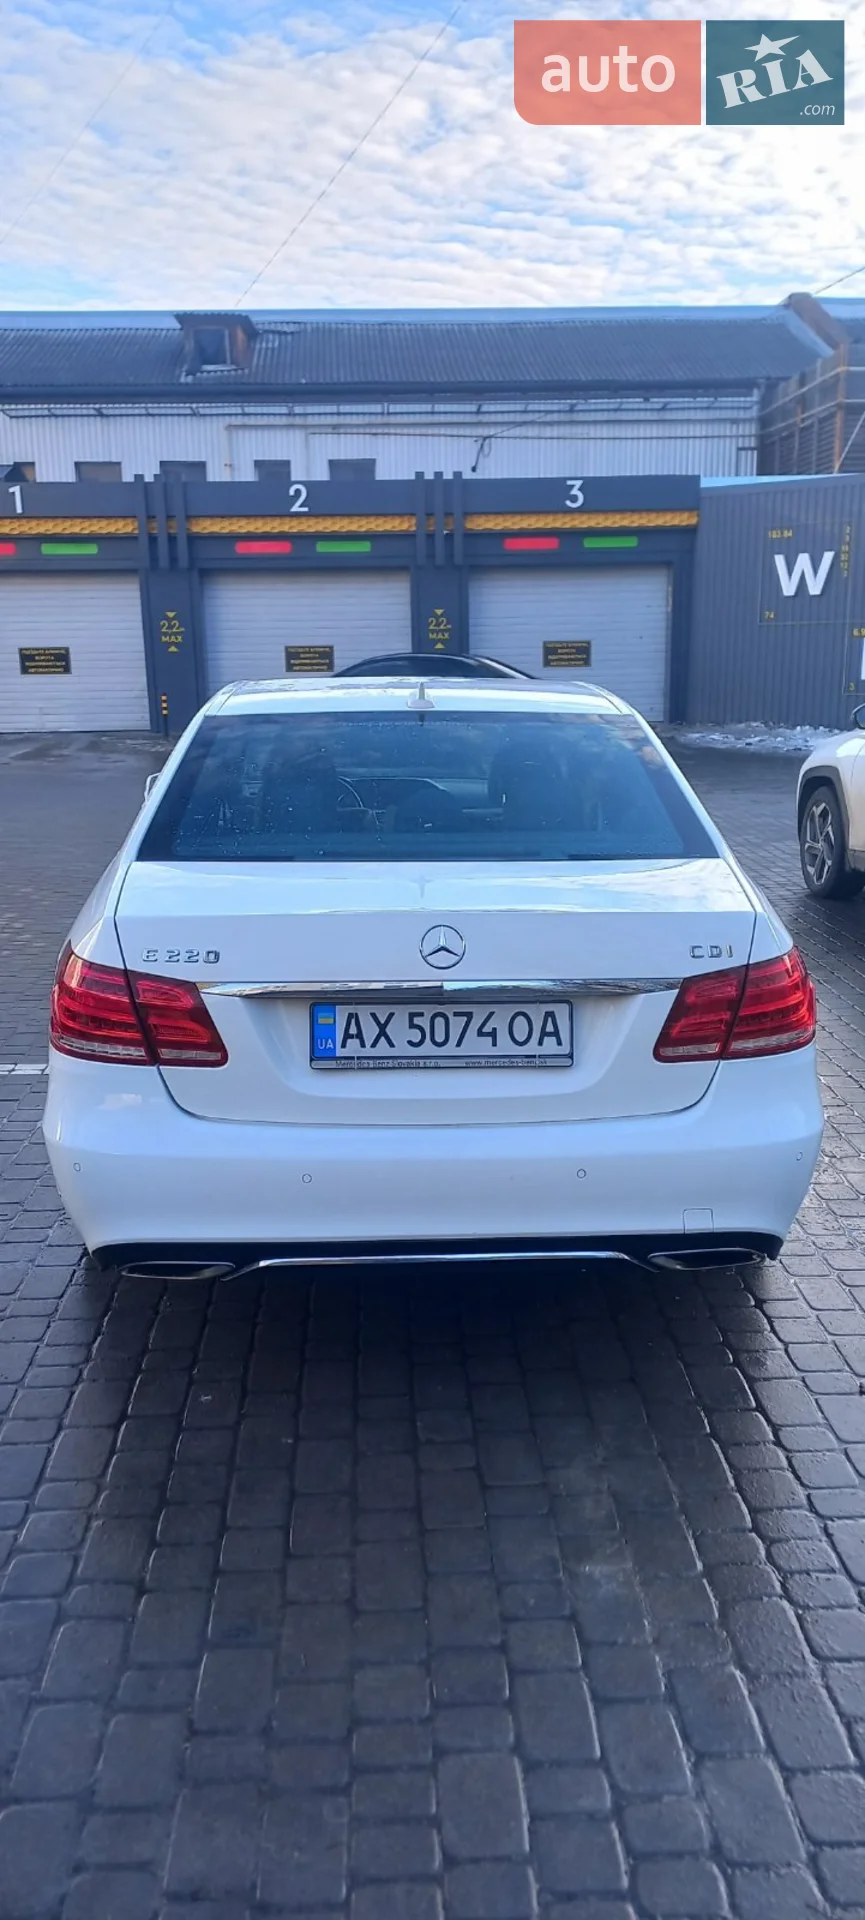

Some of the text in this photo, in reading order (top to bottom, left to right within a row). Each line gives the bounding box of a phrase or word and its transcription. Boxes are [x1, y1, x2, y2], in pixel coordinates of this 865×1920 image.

[8, 485, 24, 514] 1
[289, 483, 309, 512] 2
[564, 479, 585, 508] 3
[774, 550, 836, 596] W
[764, 611, 775, 620] 74
[160, 635, 183, 643] MAX
[429, 631, 450, 639] MAX
[849, 683, 855, 691] 3
[143, 948, 221, 964] E 220
[690, 945, 734, 959] CDI
[340, 1010, 563, 1049] AX 5074 OA
[317, 1039, 334, 1050] UA
